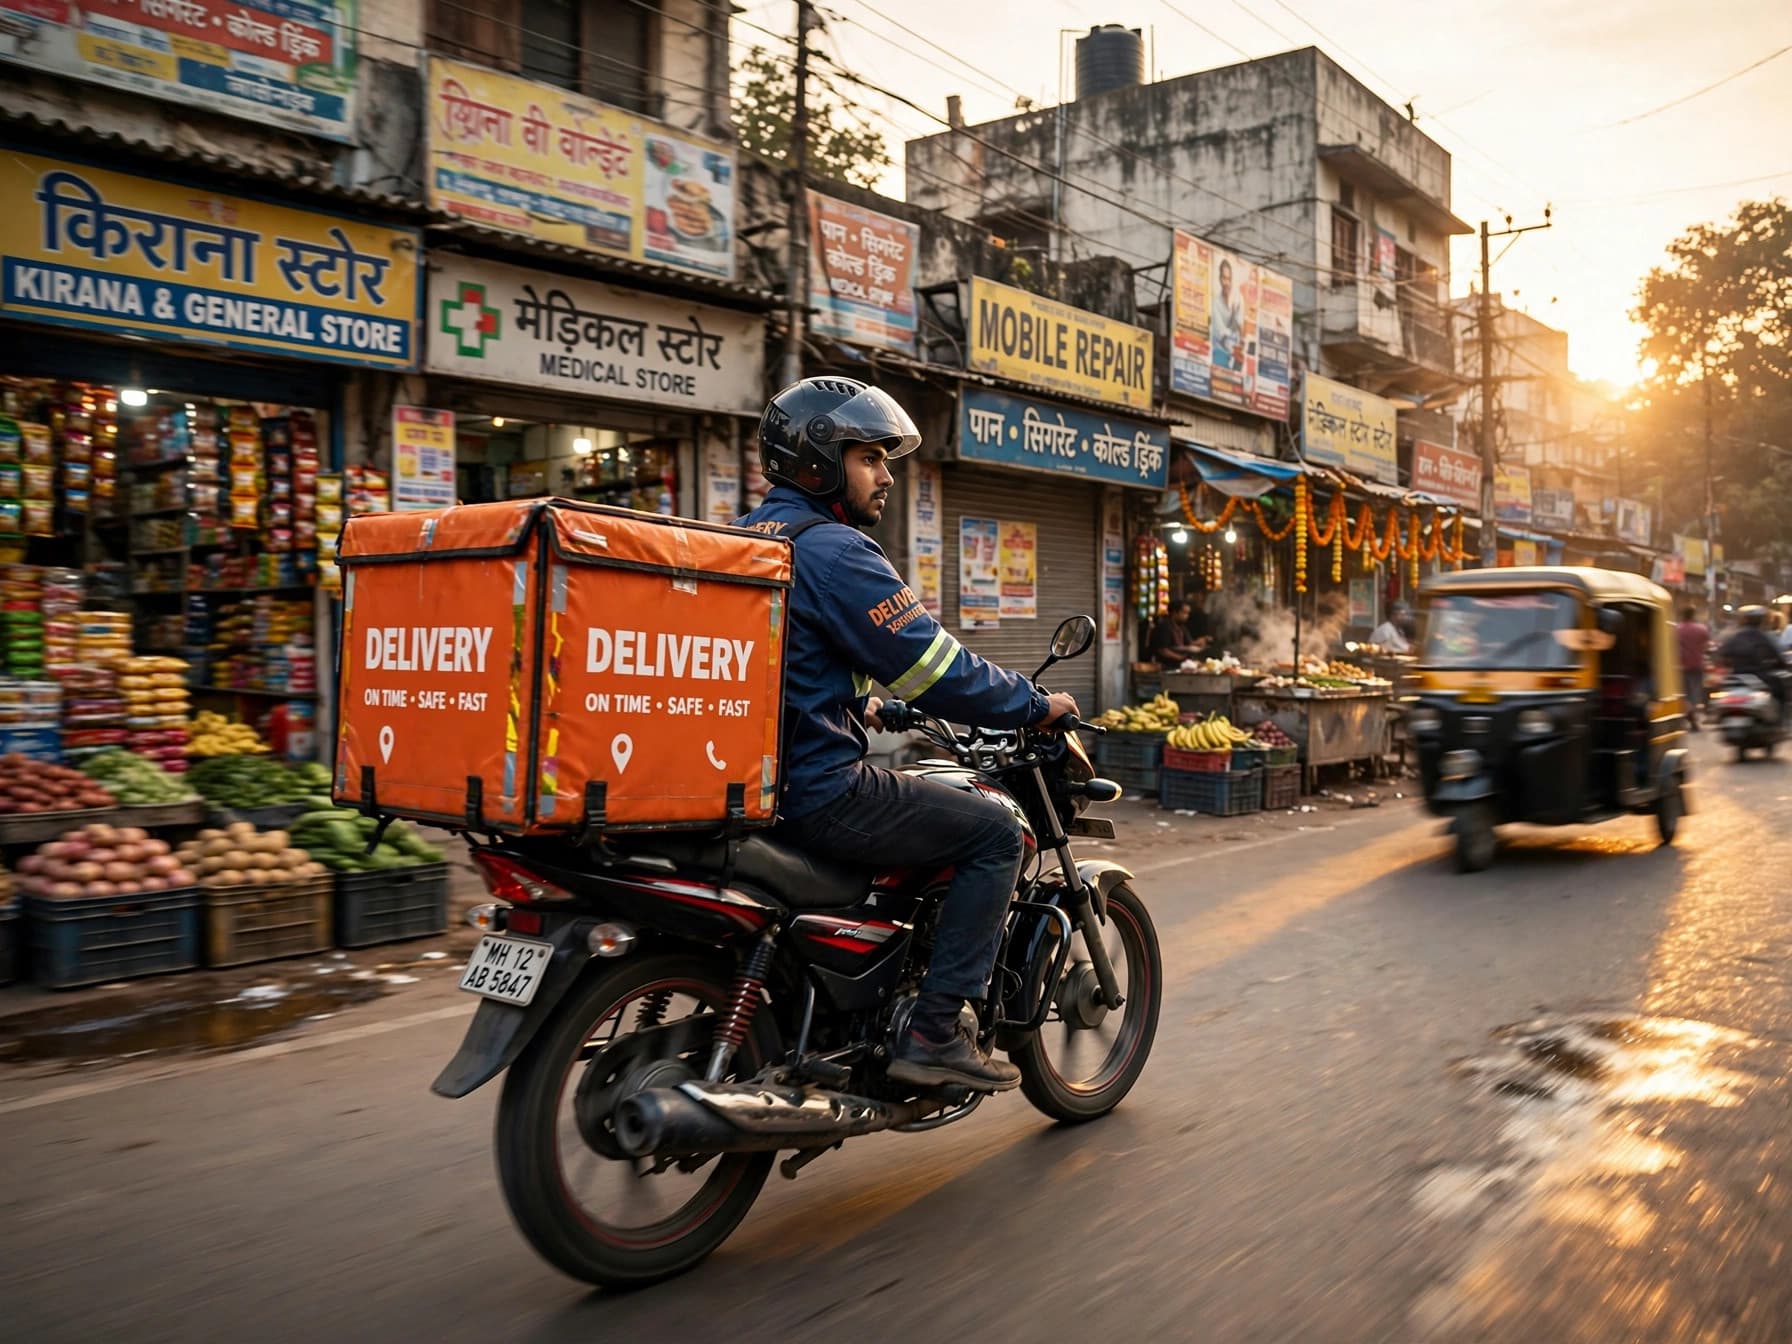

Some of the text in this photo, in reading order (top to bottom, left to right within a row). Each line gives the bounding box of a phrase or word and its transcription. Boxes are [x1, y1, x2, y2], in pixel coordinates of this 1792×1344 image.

[35, 170, 392, 305] किराना स्टोर
[820, 218, 848, 244] पान
[14, 265, 403, 353] KIRANA & GENERAL STORE
[656, 315, 725, 371] स्टोर
[979, 298, 1068, 371] MOBILE
[1075, 328, 1146, 392] REPAIR
[539, 353, 696, 396] MEDICAL STORE
[968, 406, 1164, 480] पान सिगरेट कोल्ड ड्रिंक
[365, 626, 494, 673] DELIVERY
[586, 627, 755, 682] DELIVERY
[364, 688, 488, 712] ON TIME SAFE FAST
[585, 693, 751, 717] ON TIME SAFE FAST
[484, 942, 534, 971] MH 12
[463, 964, 533, 998] AB 5847
